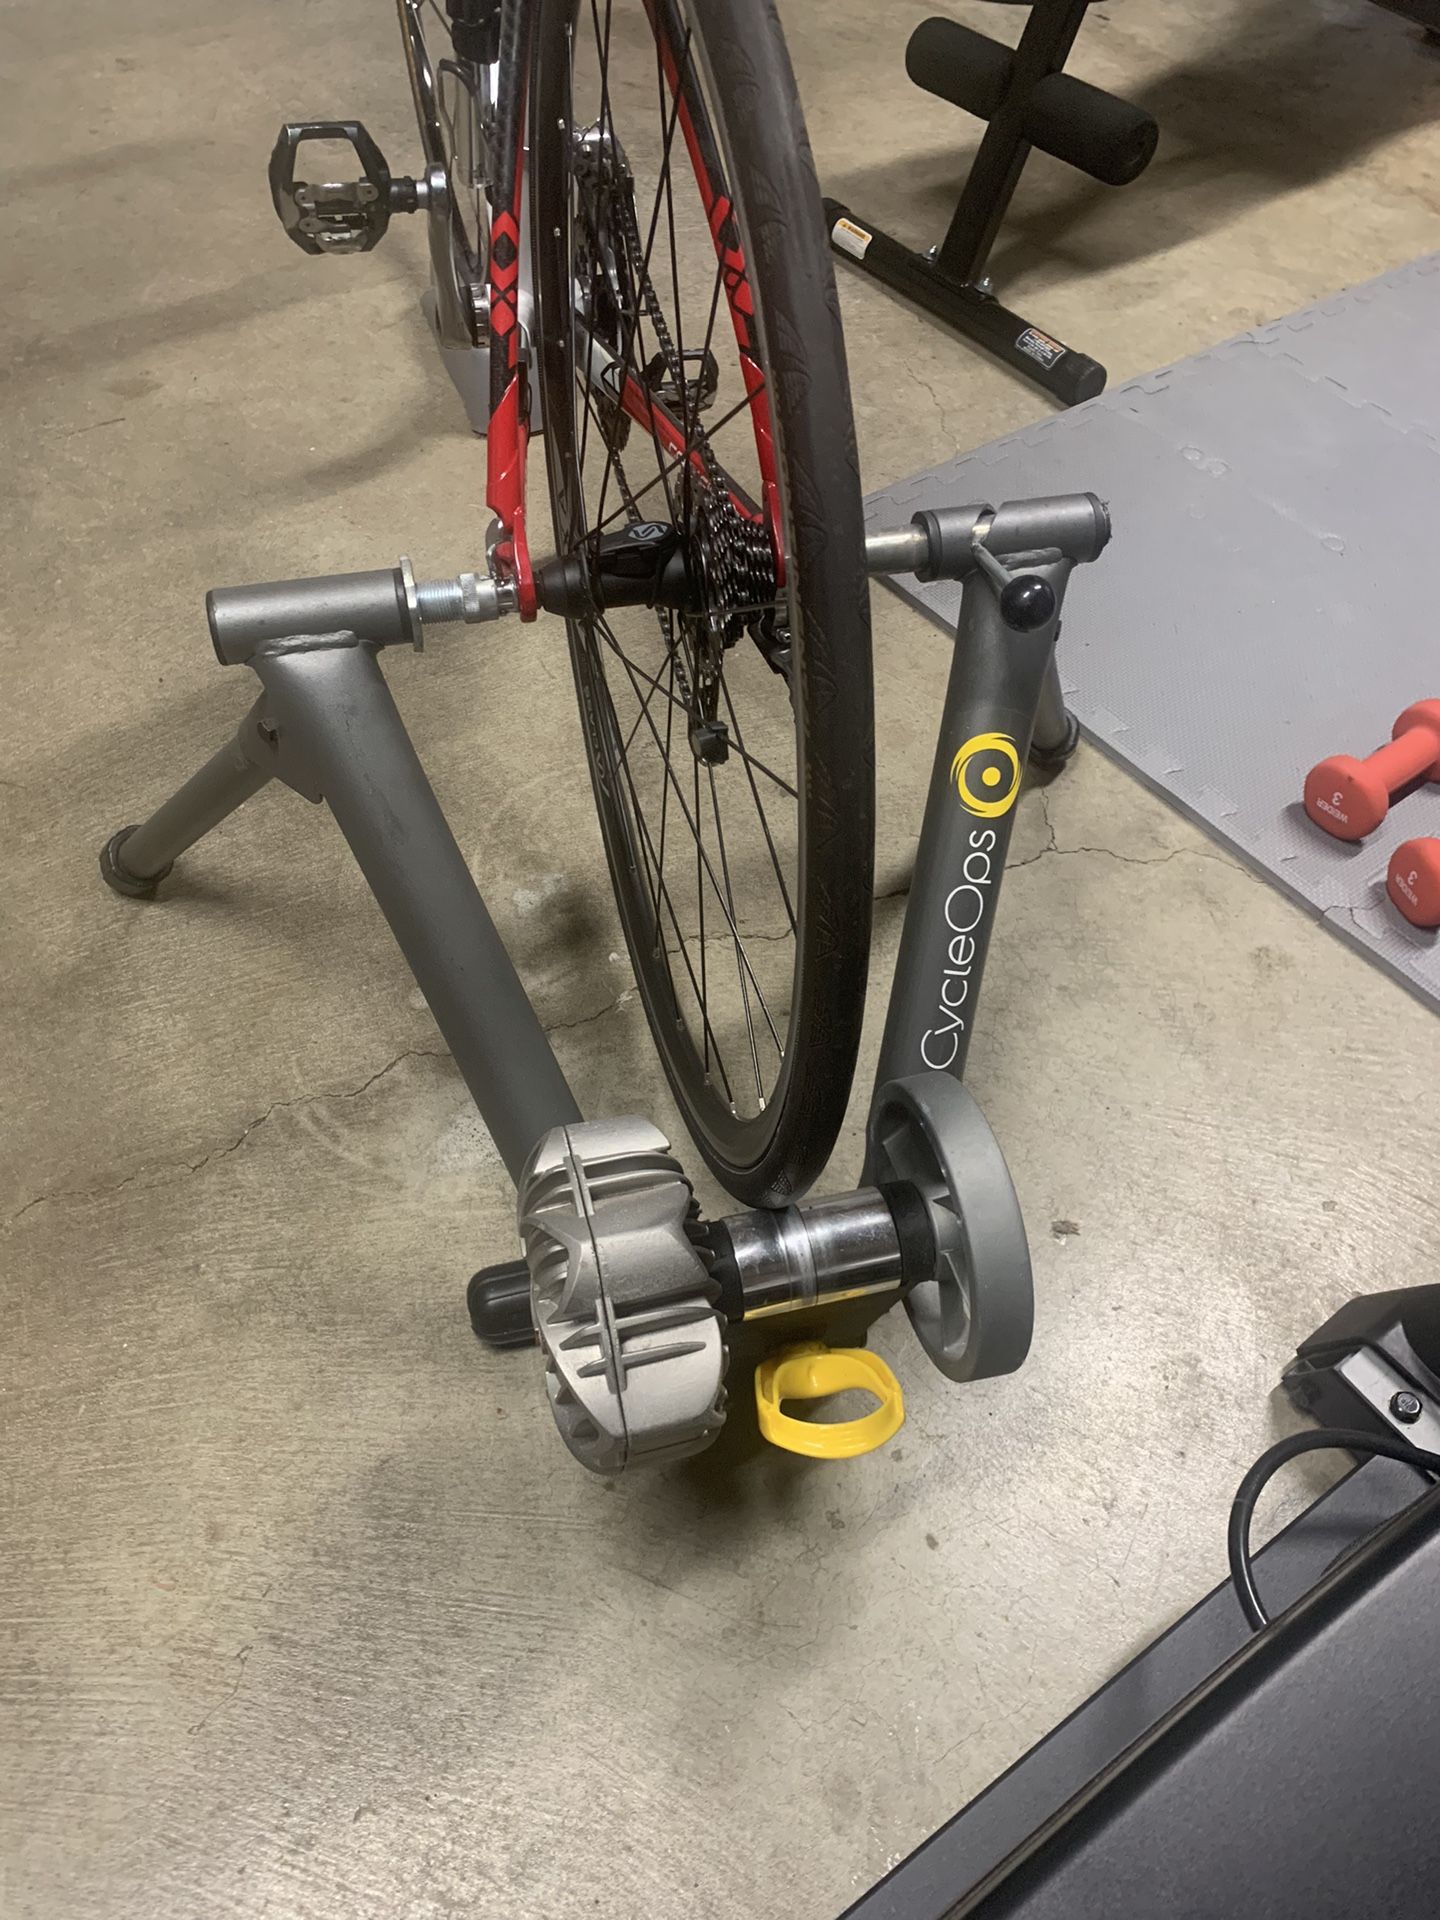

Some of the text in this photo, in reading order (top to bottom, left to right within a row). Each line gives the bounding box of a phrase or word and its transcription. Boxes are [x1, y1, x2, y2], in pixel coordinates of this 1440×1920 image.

[1332, 791, 1343, 806] 3
[1316, 797, 1348, 823] WEIDER
[1408, 870, 1418, 885] 3
[921, 829, 996, 1069] CycleOps
